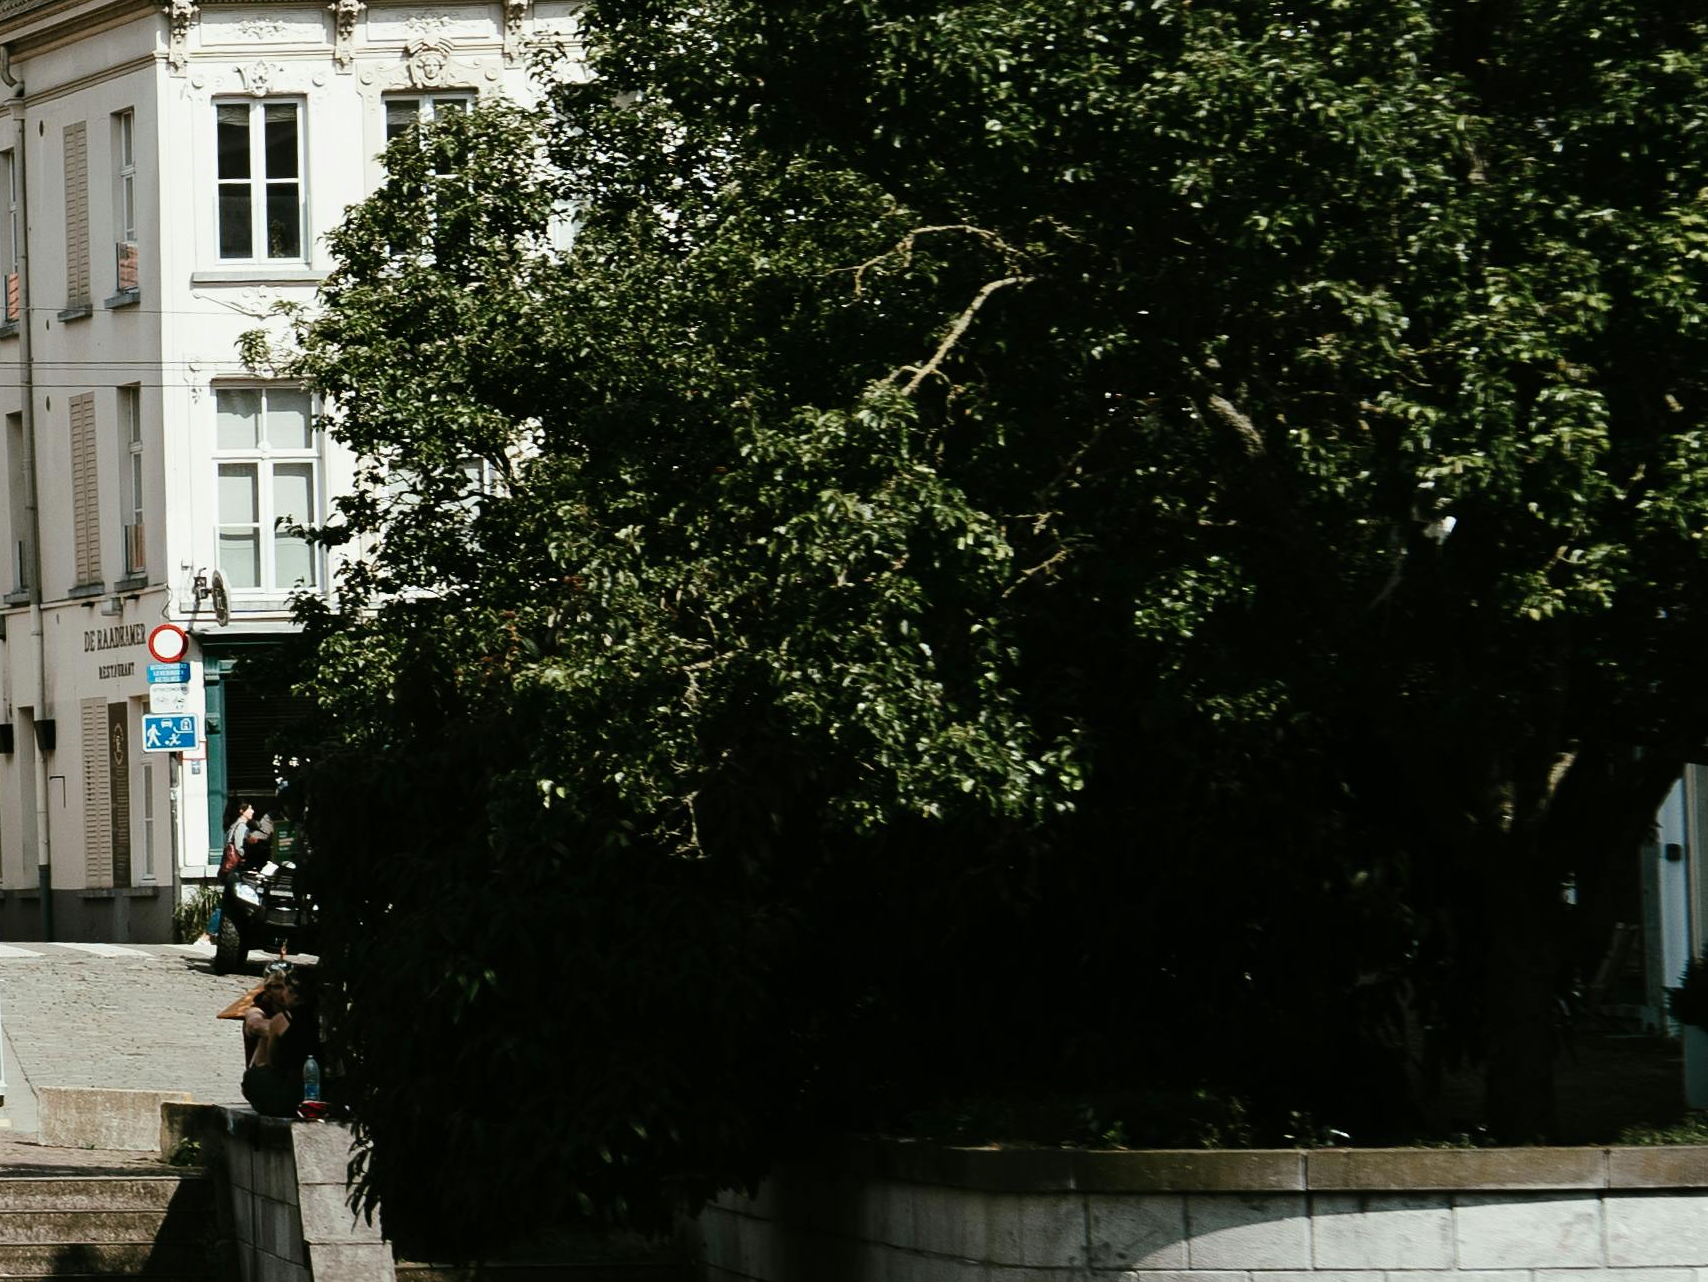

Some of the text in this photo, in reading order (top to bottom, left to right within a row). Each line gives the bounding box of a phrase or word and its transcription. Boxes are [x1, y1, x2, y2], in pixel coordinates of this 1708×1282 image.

[83, 623, 146, 653] DE RAADKAMER
[98, 662, 135, 679] RESTAURANT
